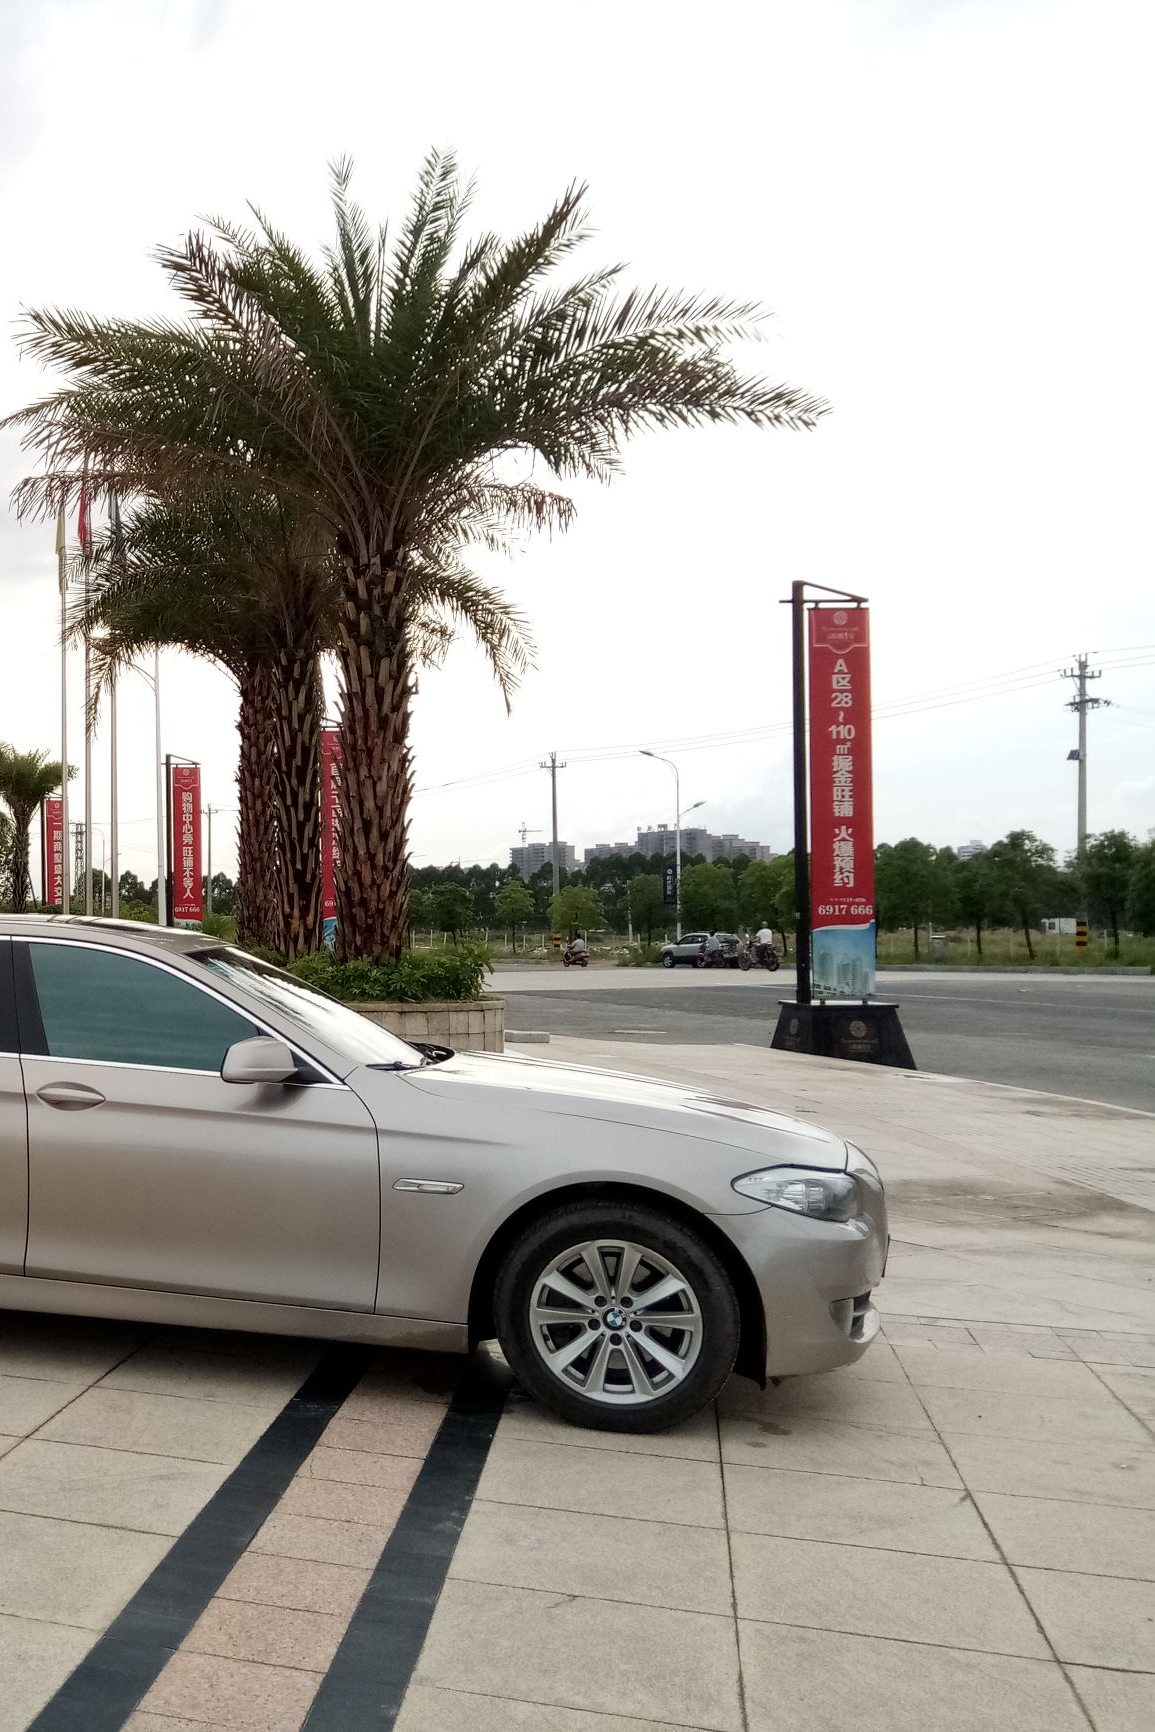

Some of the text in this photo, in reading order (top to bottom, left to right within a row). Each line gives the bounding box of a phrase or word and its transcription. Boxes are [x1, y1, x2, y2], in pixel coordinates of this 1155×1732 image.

[182, 847, 194, 899] 旺铺不等人
[832, 825, 855, 888] 火爆预约
[818, 904, 874, 915] 6917 666
